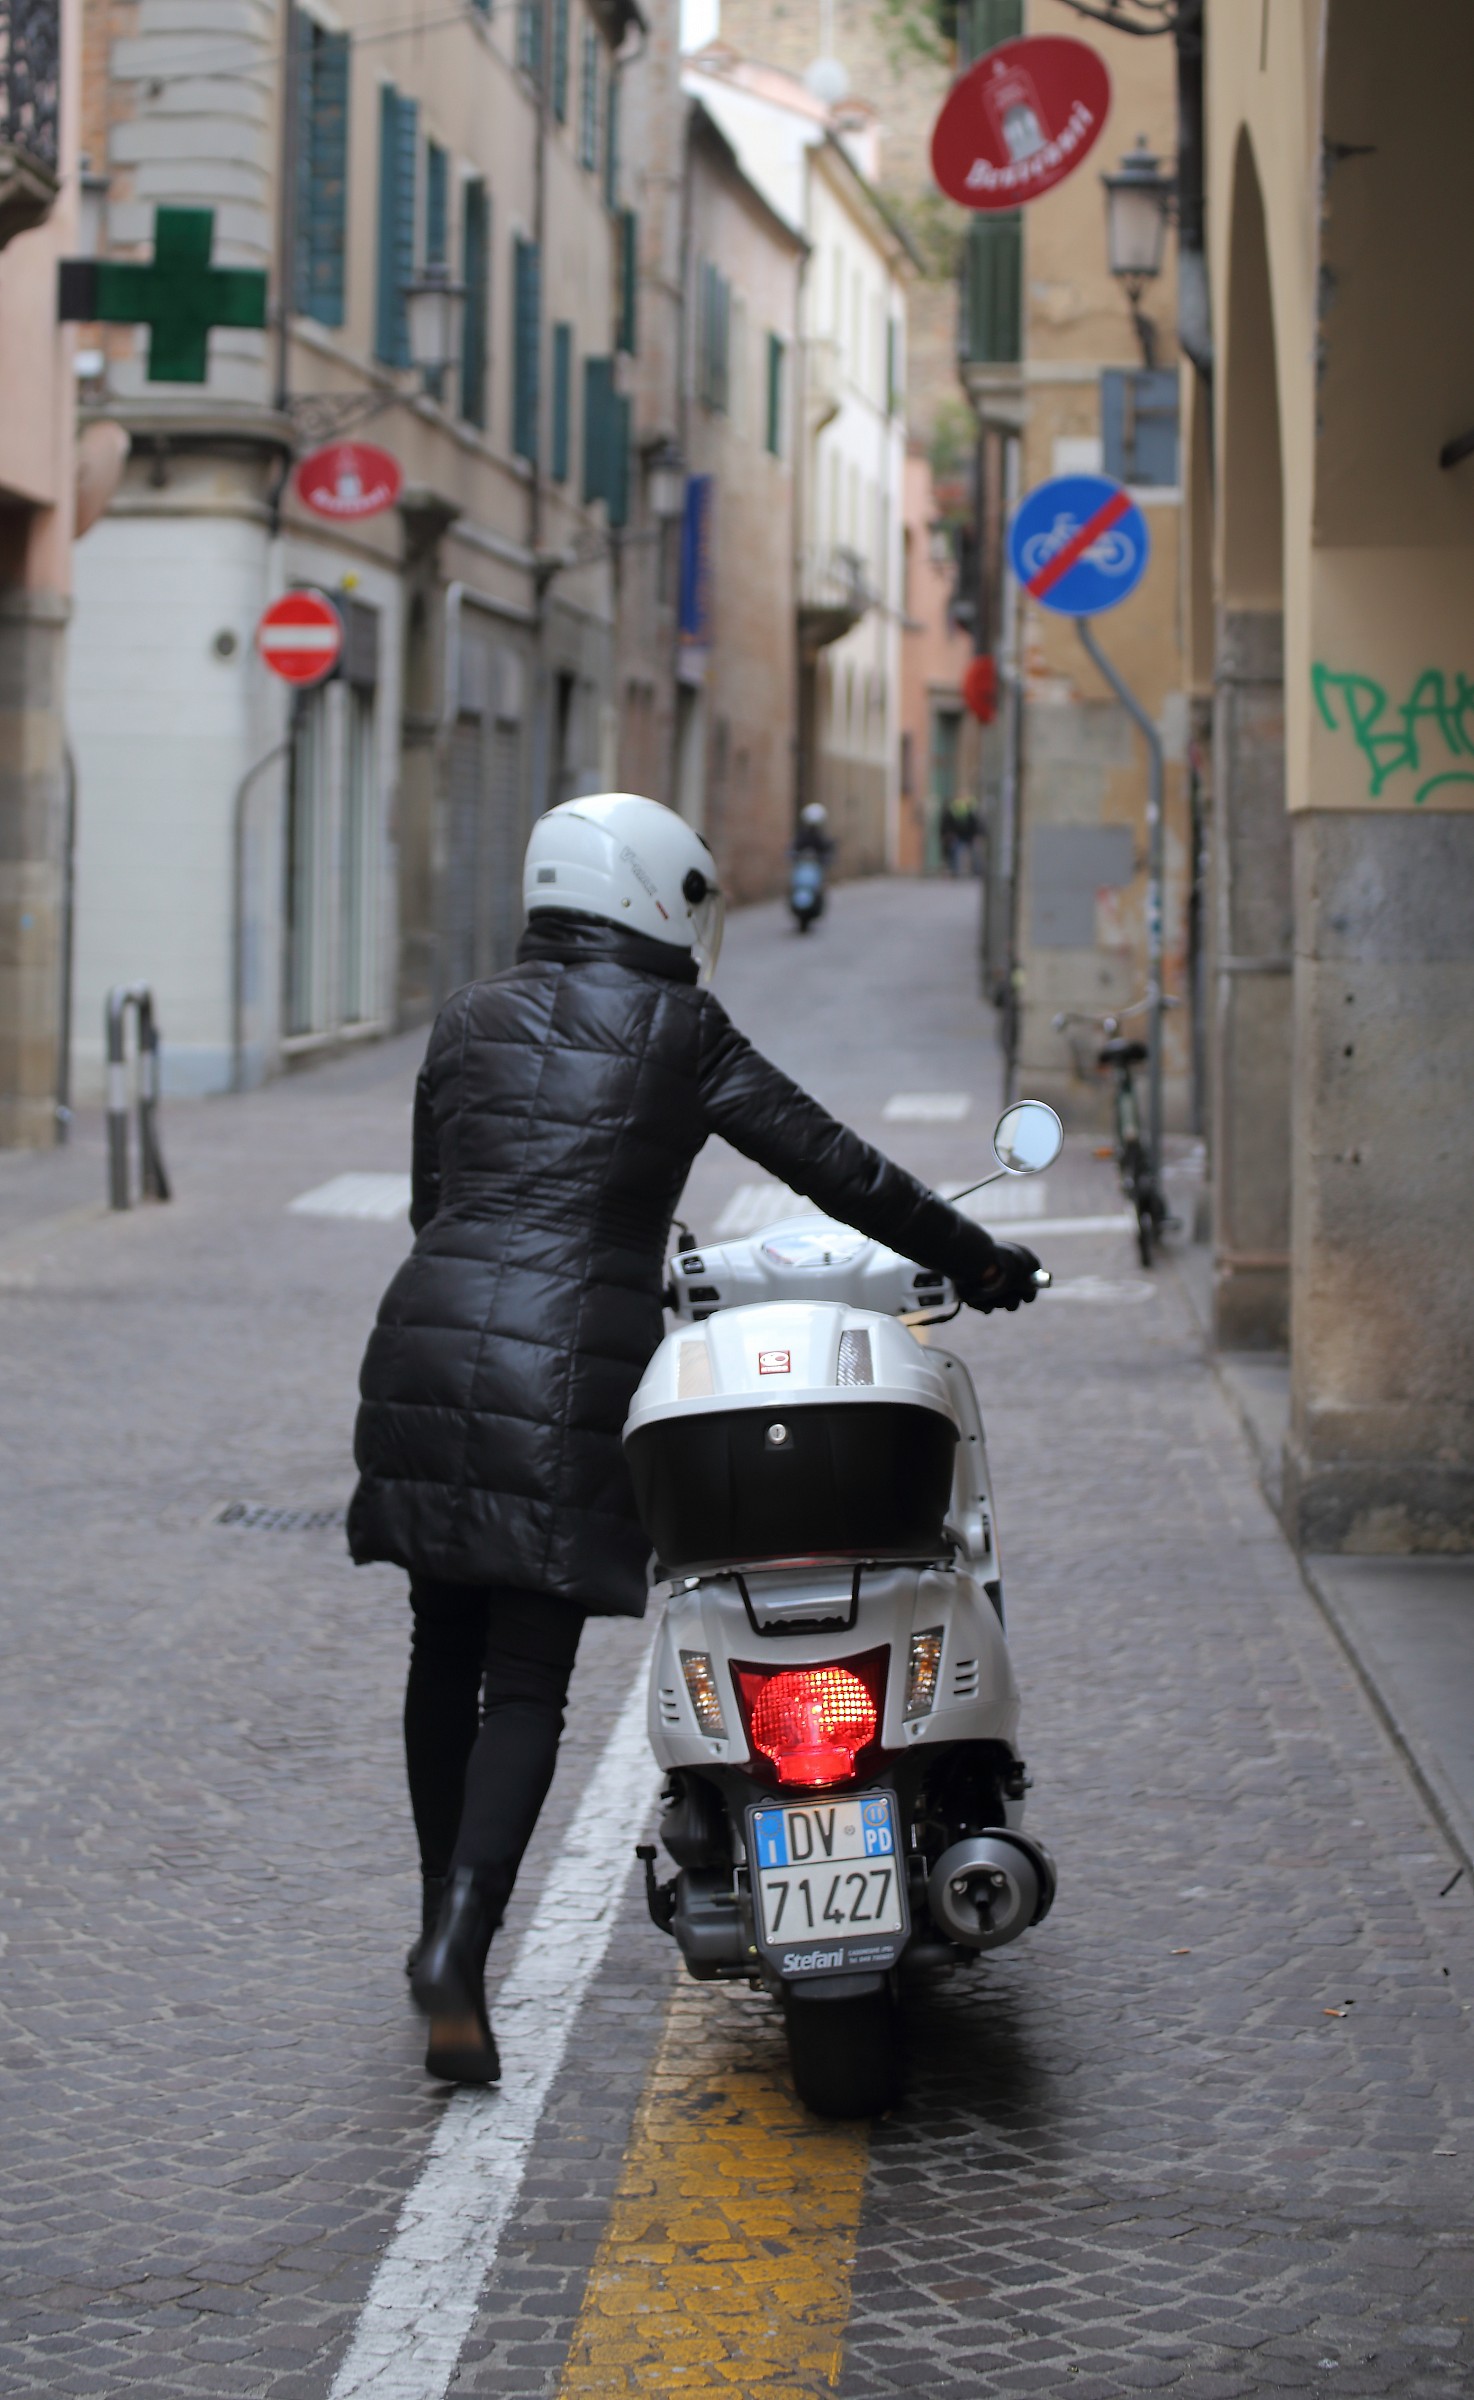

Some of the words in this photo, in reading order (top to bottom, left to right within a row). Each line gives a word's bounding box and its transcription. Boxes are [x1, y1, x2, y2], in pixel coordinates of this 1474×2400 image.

[965, 99, 1094, 191] Benvenuti
[768, 1839, 778, 1864] I
[788, 1808, 836, 1861] DV
[865, 1827, 893, 1854] PD
[766, 1868, 892, 1932] 71427
[782, 1948, 844, 1973] Stefani
